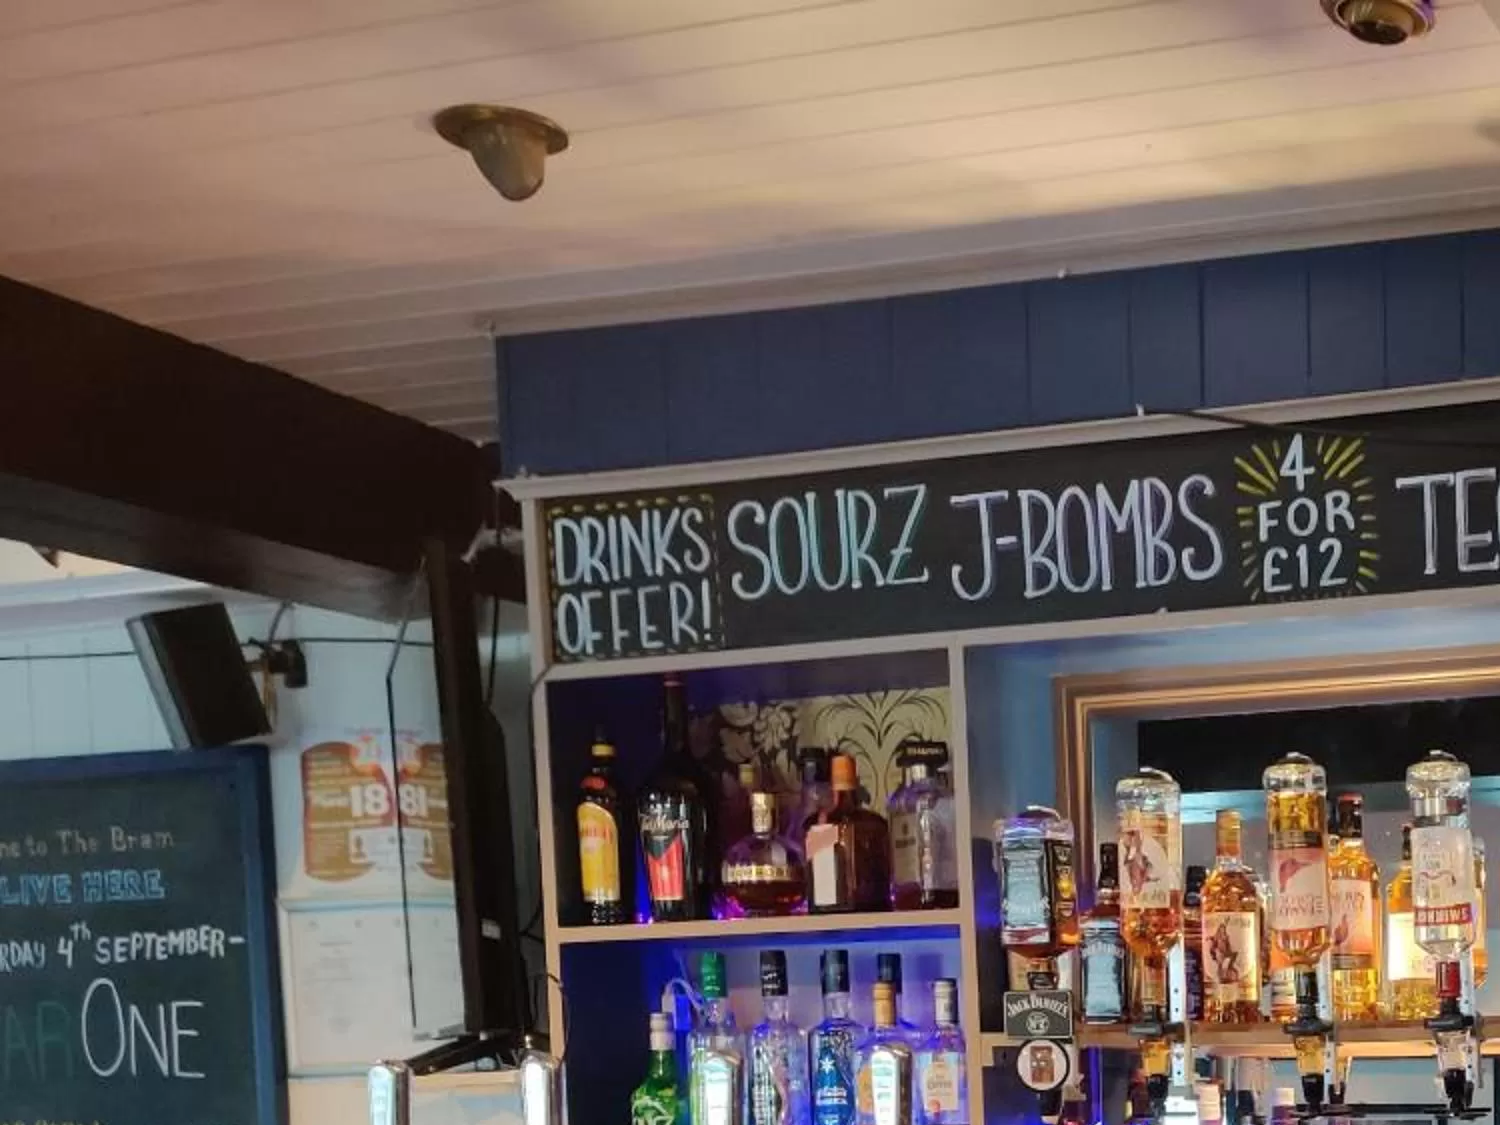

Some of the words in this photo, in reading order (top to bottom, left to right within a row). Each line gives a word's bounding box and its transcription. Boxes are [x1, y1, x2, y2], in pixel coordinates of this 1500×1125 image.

[1280, 433, 1314, 490] 4
[554, 507, 711, 586] DRINKS
[727, 483, 929, 600] SOURZ
[950, 473, 1224, 600] J-BOMBS
[1258, 490, 1356, 542] FOR
[557, 577, 712, 654] OFFER!
[57, 829, 97, 854] The
[82, 869, 165, 903] HERE
[82, 978, 206, 1077] ONE
